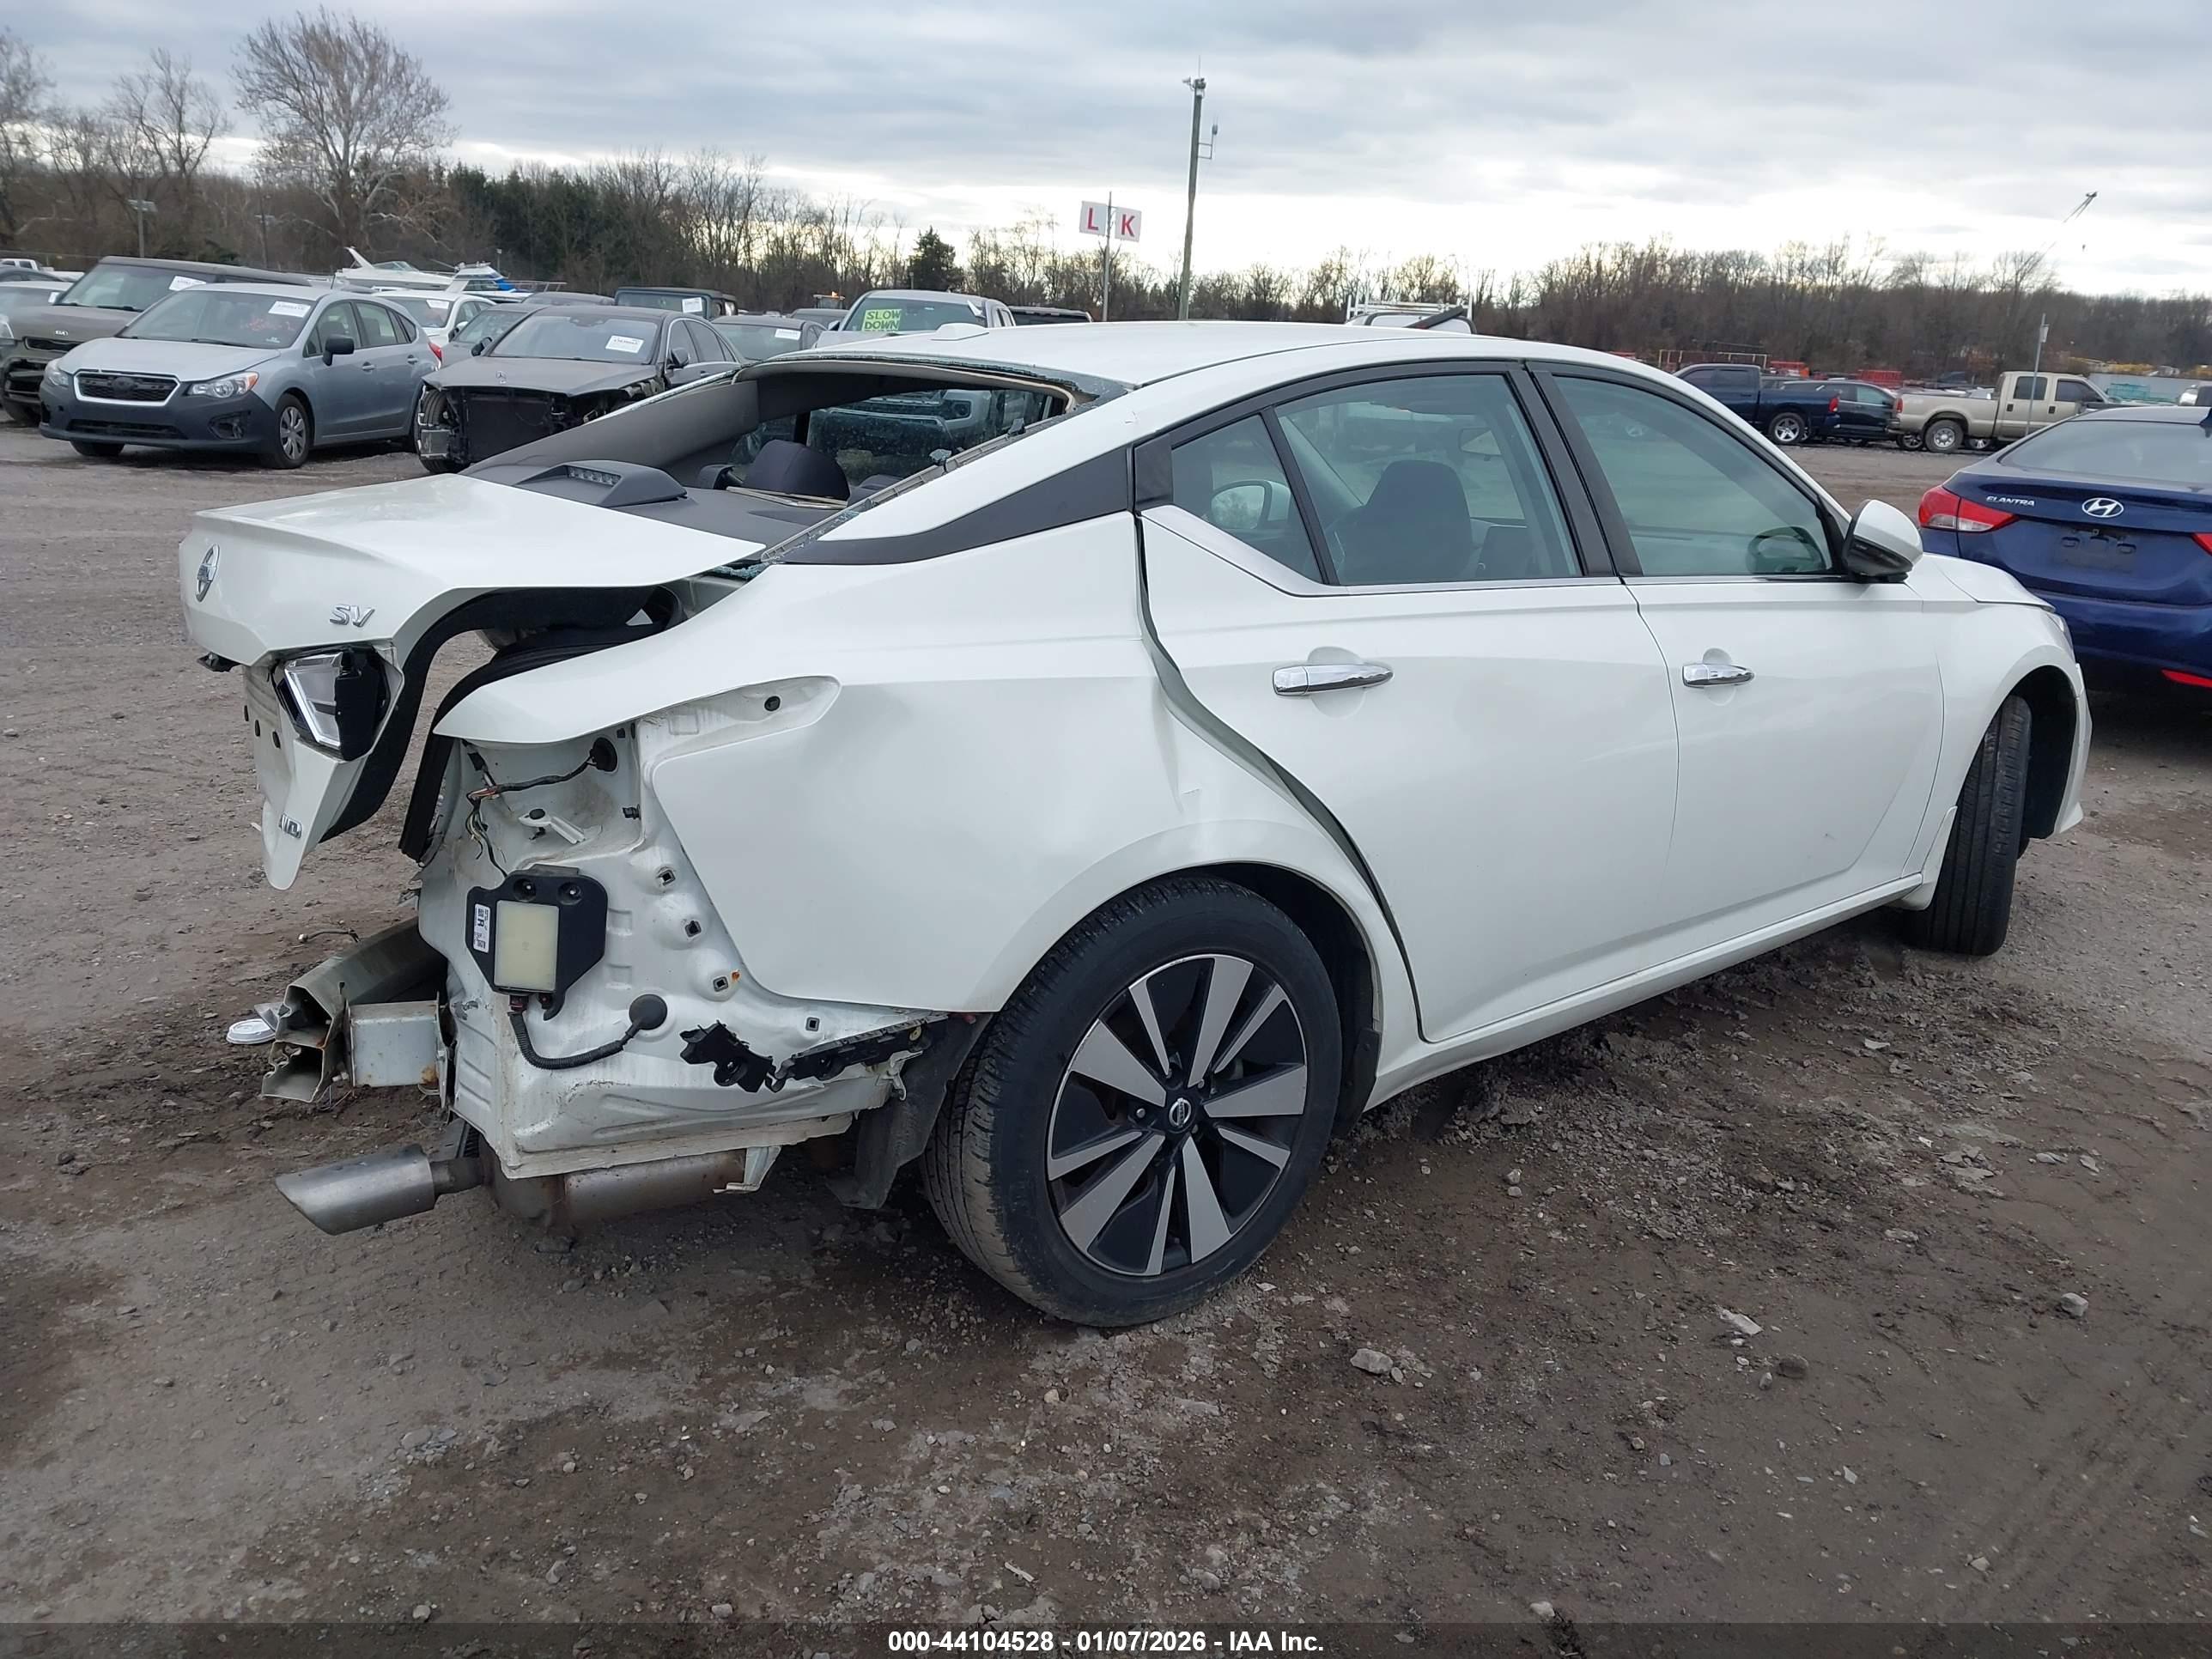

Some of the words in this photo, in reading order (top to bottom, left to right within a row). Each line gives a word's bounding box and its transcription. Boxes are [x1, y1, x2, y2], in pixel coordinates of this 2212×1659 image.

[1087, 207, 1099, 231] L
[1121, 213, 1135, 238] K
[866, 310, 901, 319] SLOW
[864, 320, 899, 330] DOWN
[1985, 495, 2035, 507] ELANTRA
[329, 604, 375, 628] SV
